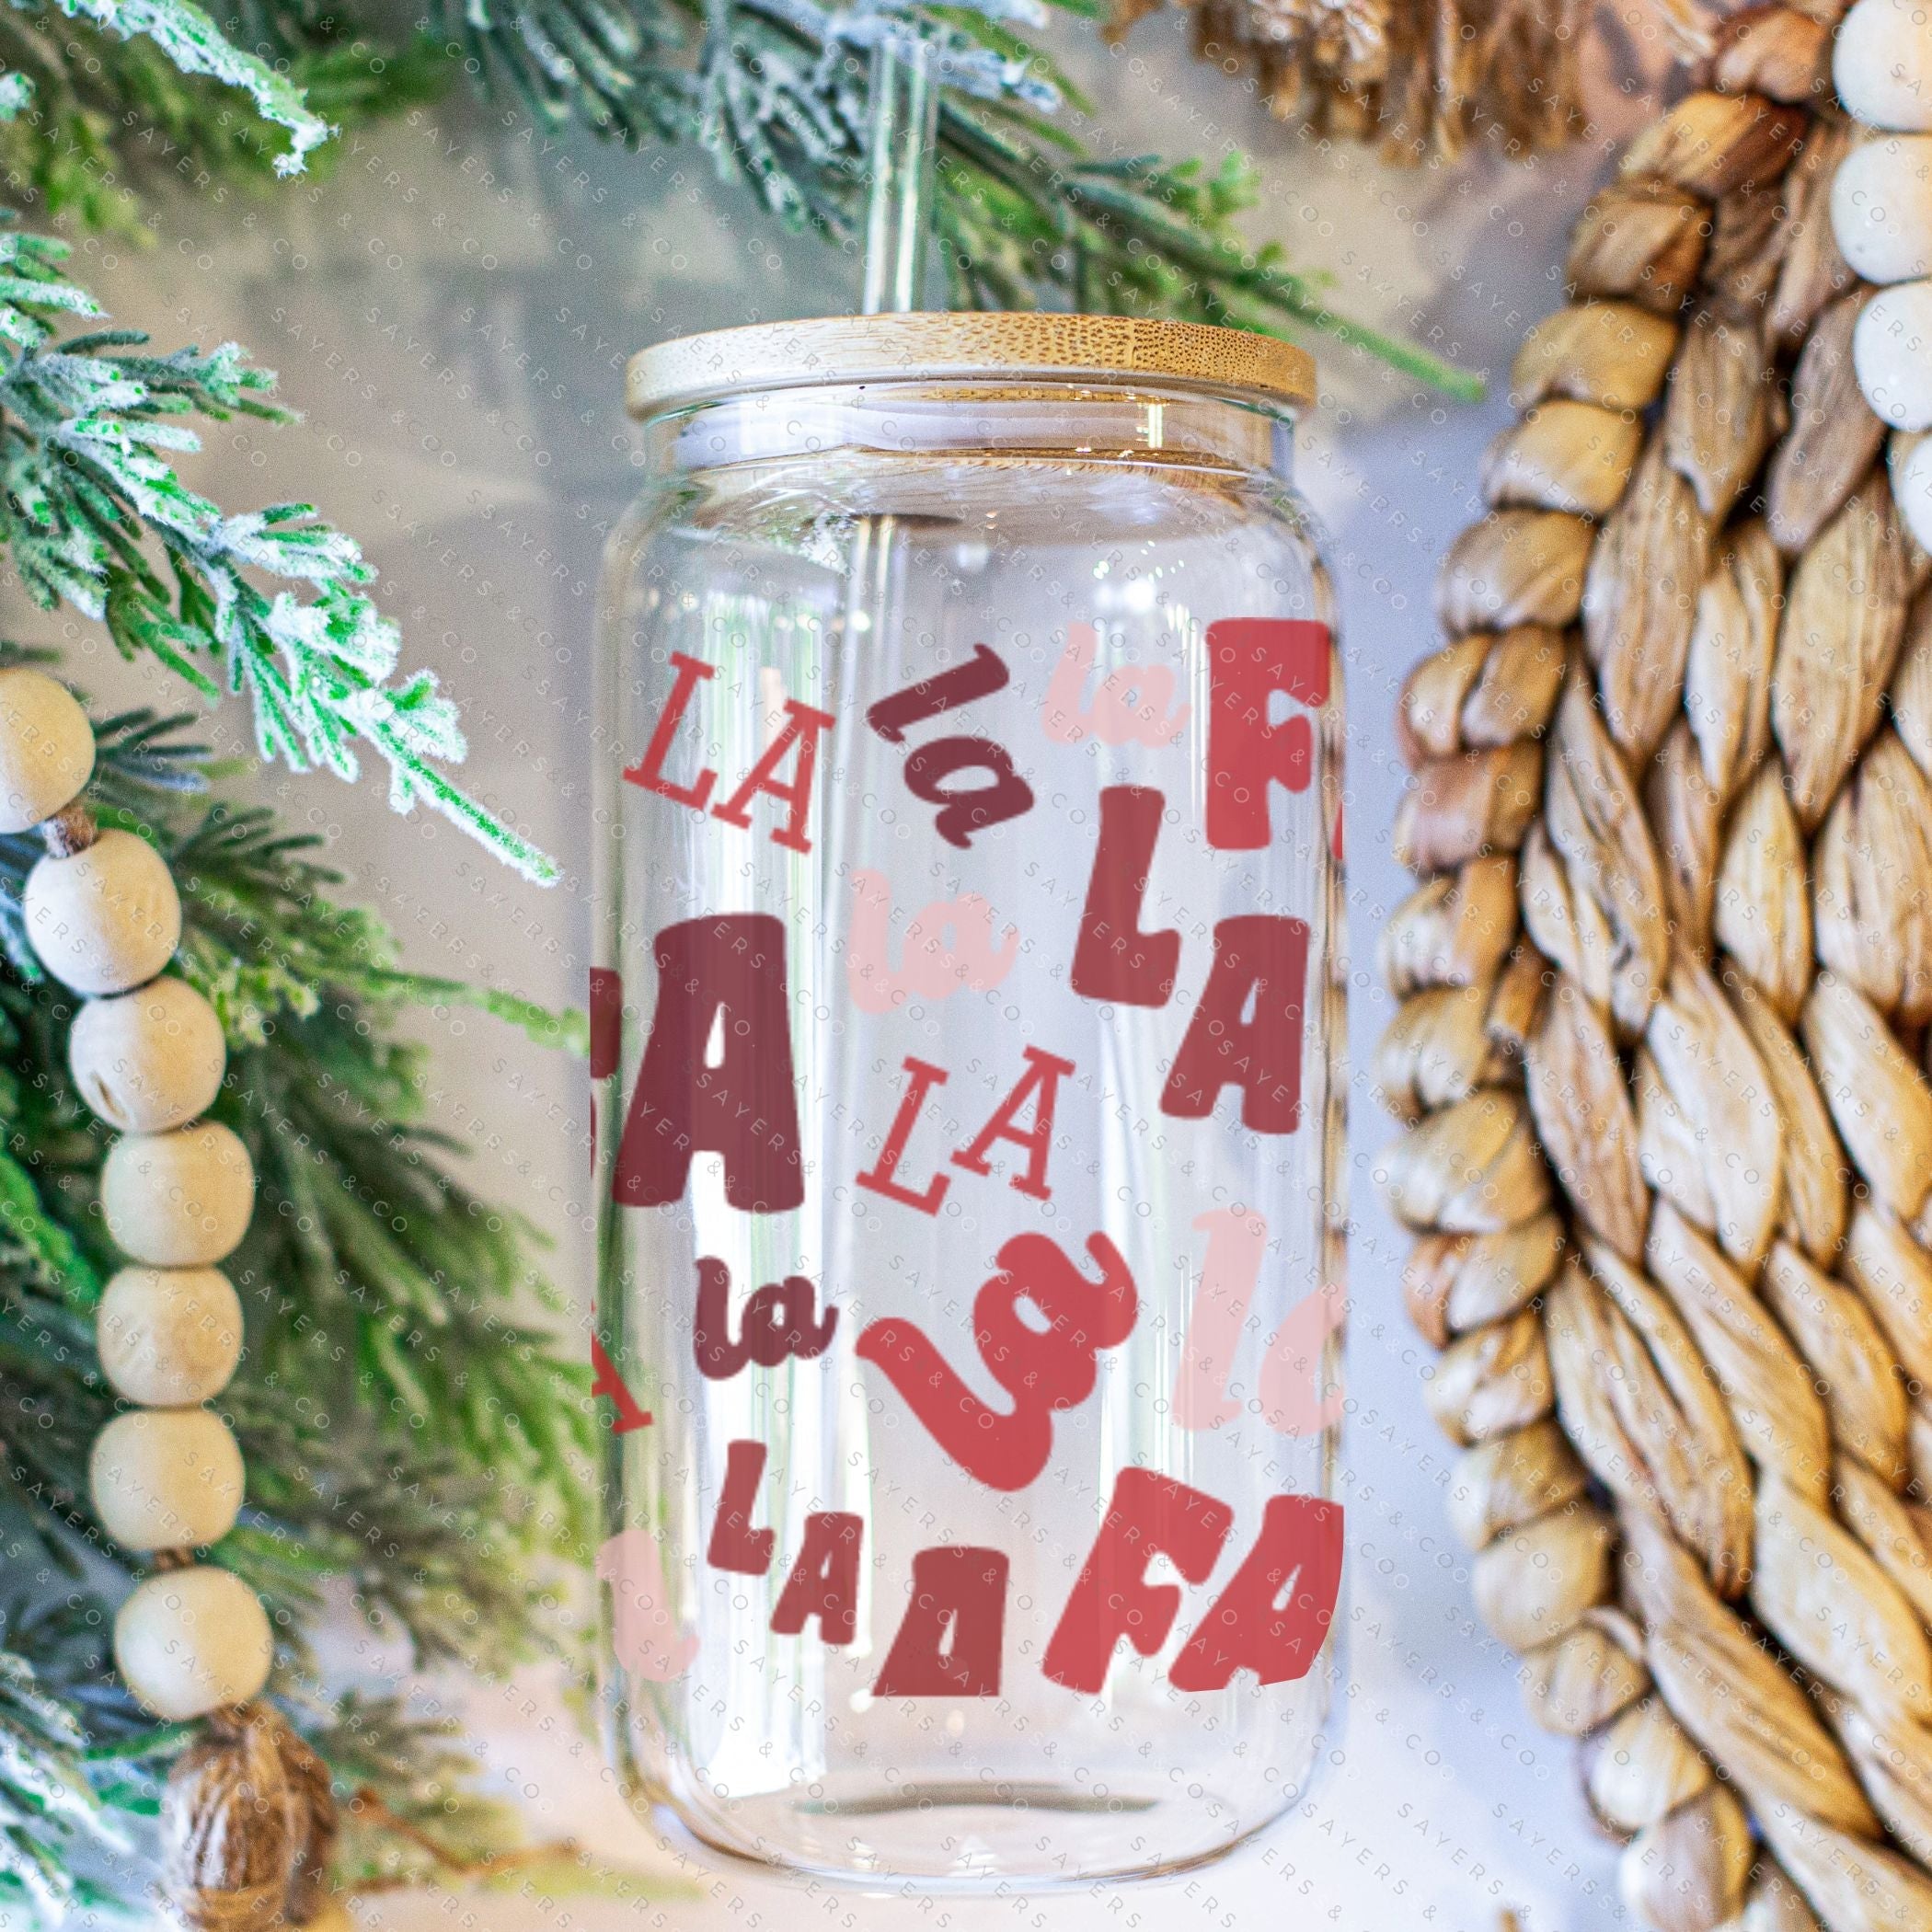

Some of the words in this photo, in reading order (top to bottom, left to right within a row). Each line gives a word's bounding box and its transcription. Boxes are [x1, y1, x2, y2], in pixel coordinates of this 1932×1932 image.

[622, 650, 836, 856] LA
[866, 643, 1034, 849] la
[1041, 621, 1193, 748] la
[1205, 616, 1343, 861] F
[848, 868, 1019, 1014] la
[1070, 784, 1310, 1134] LA
[856, 1045, 1075, 1217] LA
[693, 1256, 839, 1381] la
[856, 1231, 1138, 1492] la
[707, 1439, 864, 1645] LA
[1041, 1466, 1343, 1693] FA
